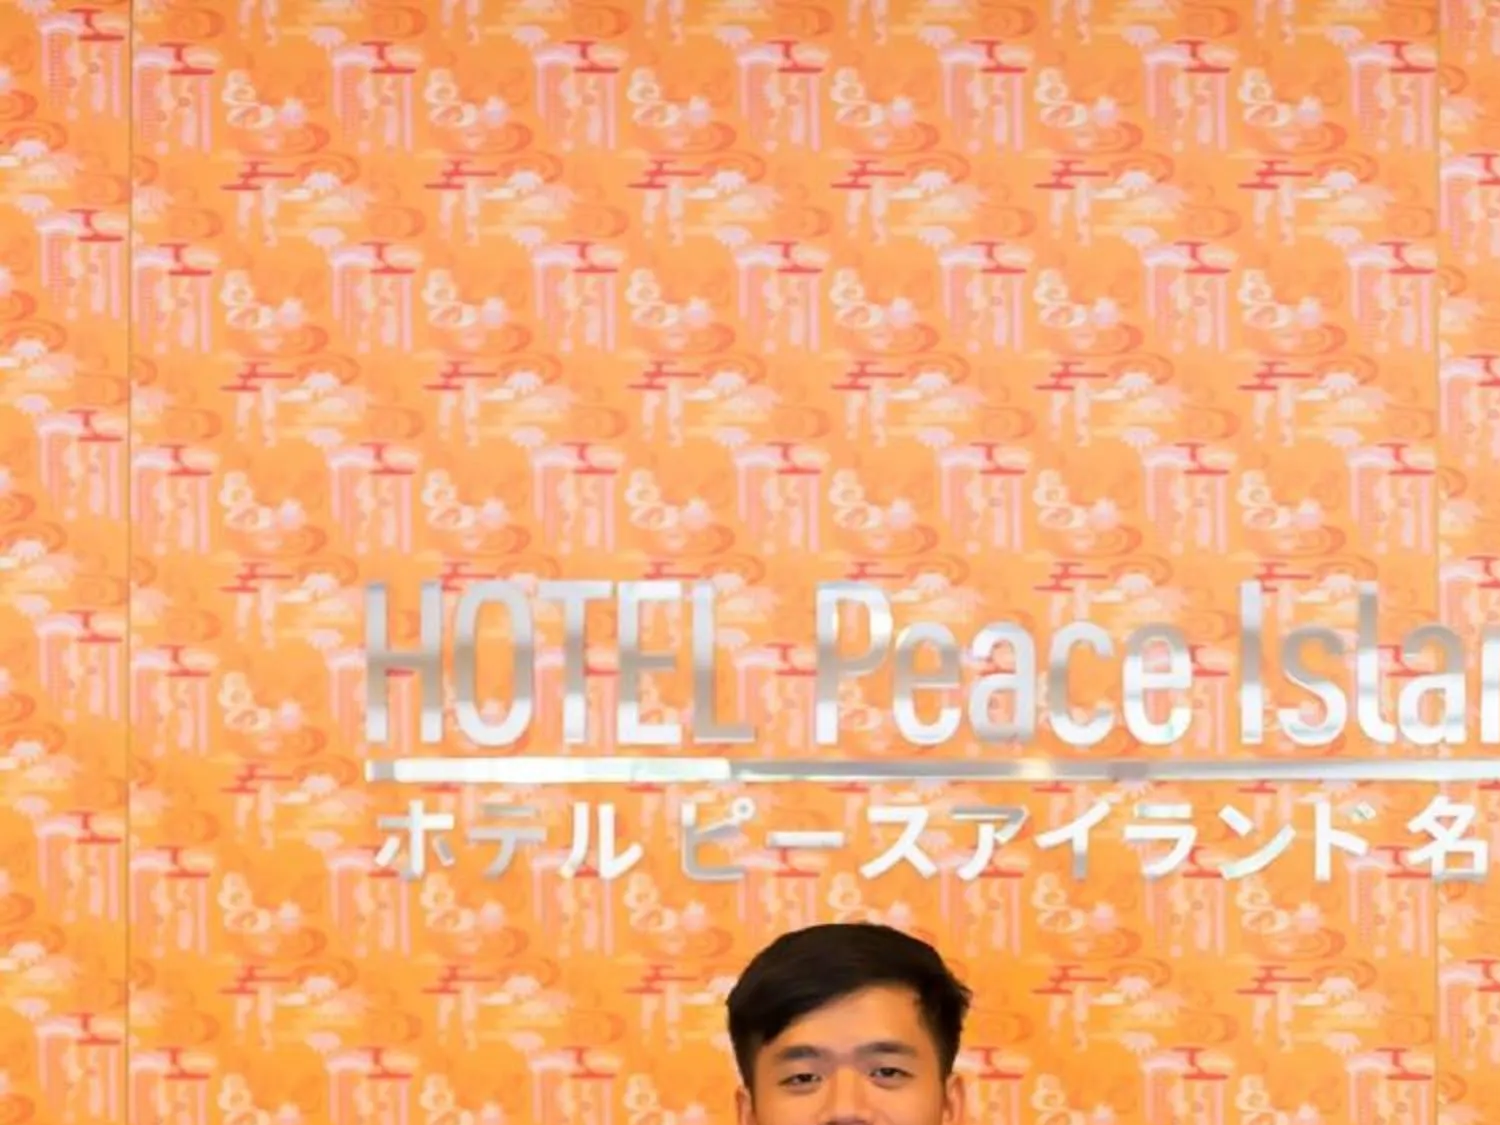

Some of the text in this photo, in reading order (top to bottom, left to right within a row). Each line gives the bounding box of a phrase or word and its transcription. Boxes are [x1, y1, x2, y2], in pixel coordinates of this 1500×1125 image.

[364, 580, 756, 746] HOTEL
[814, 580, 1192, 746] Peace
[374, 800, 643, 879] ホテル
